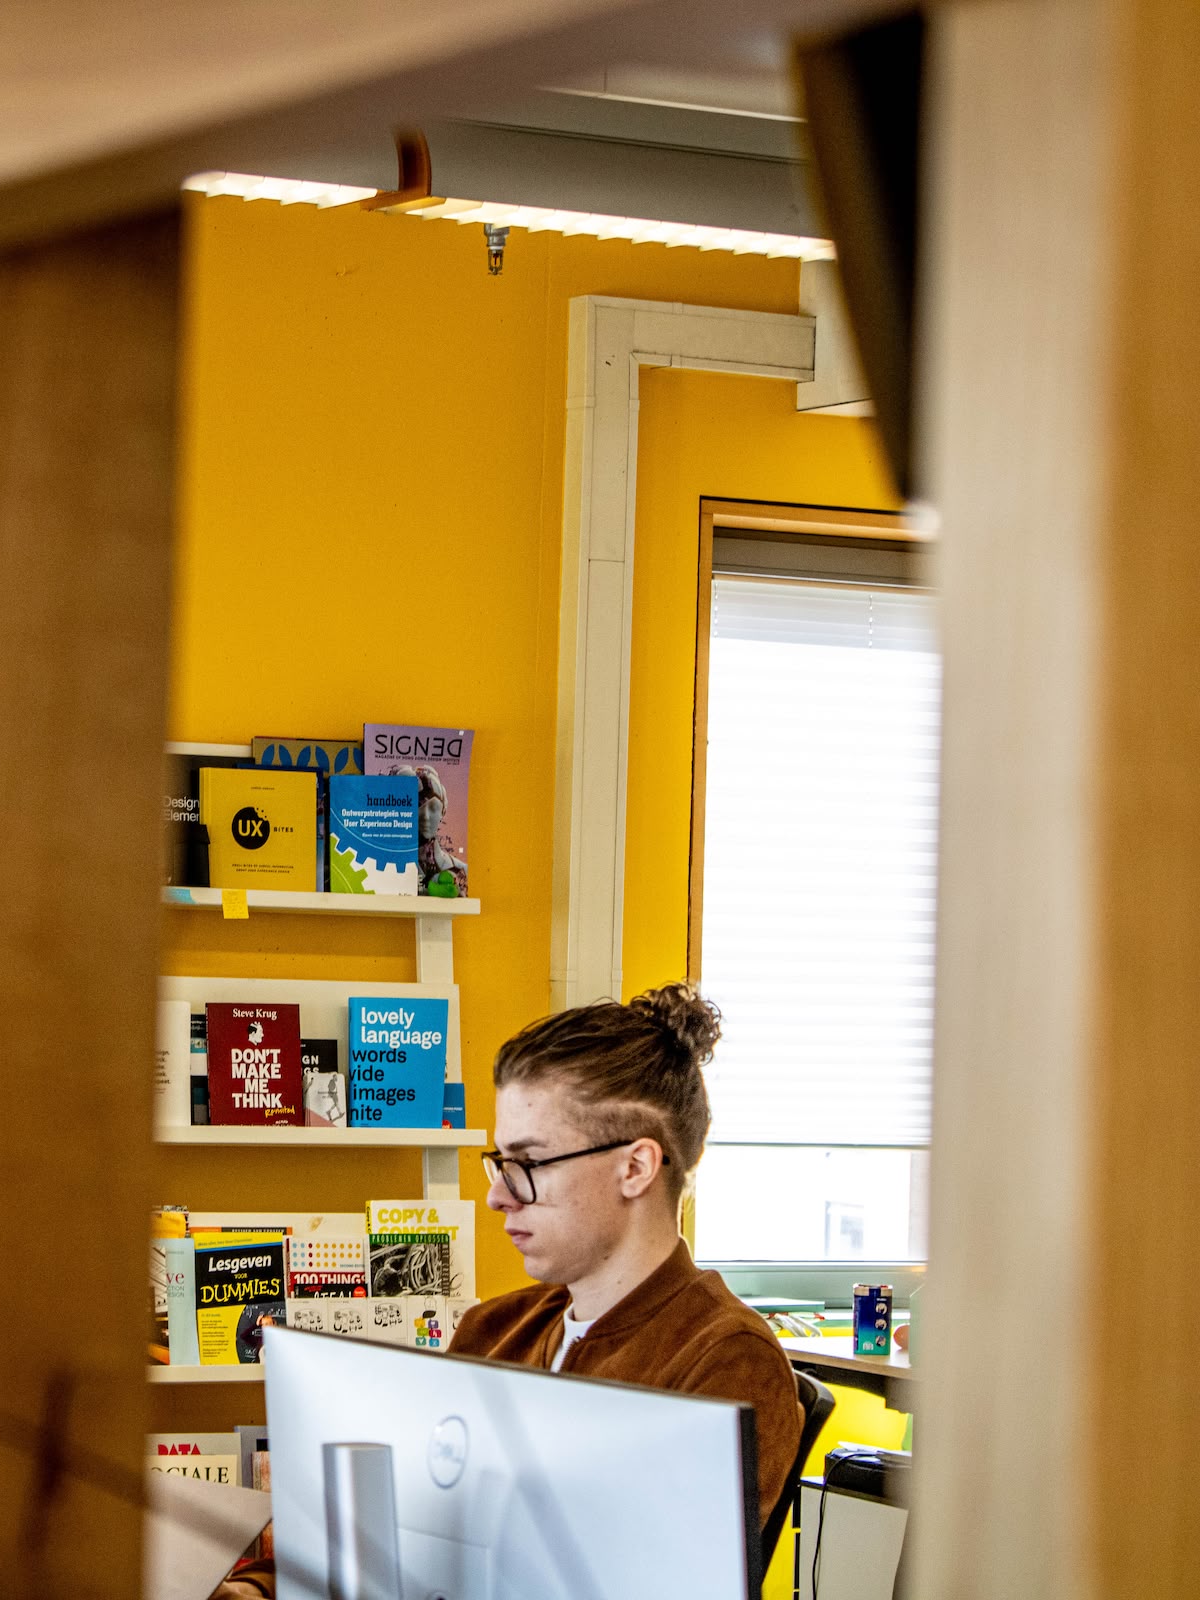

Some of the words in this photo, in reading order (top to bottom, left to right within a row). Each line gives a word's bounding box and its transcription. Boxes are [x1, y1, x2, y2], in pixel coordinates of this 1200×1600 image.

[164, 796, 200, 811] Design
[367, 794, 412, 806] handboek
[238, 819, 263, 837] UX
[343, 819, 358, 828] User
[360, 819, 392, 829] Experience
[394, 820, 412, 829] Design
[232, 1008, 255, 1018] Steve
[256, 1009, 277, 1020] Krug
[362, 1007, 415, 1030] lovely
[361, 1026, 442, 1050] language
[231, 1048, 281, 1064] DON'T
[302, 1055, 319, 1065] GN
[352, 1048, 406, 1063] words
[232, 1063, 281, 1078] MAKE
[245, 1079, 269, 1093] ME
[232, 1093, 282, 1108] THINK
[353, 1084, 416, 1106] images
[377, 1208, 426, 1224] COPY
[427, 1208, 439, 1224] &
[208, 1255, 272, 1273] Lesgeven
[294, 1274, 318, 1284] 100
[200, 1278, 280, 1303] DUMMIES
[158, 1443, 200, 1455] DATA
[152, 1467, 229, 1483] IALE
